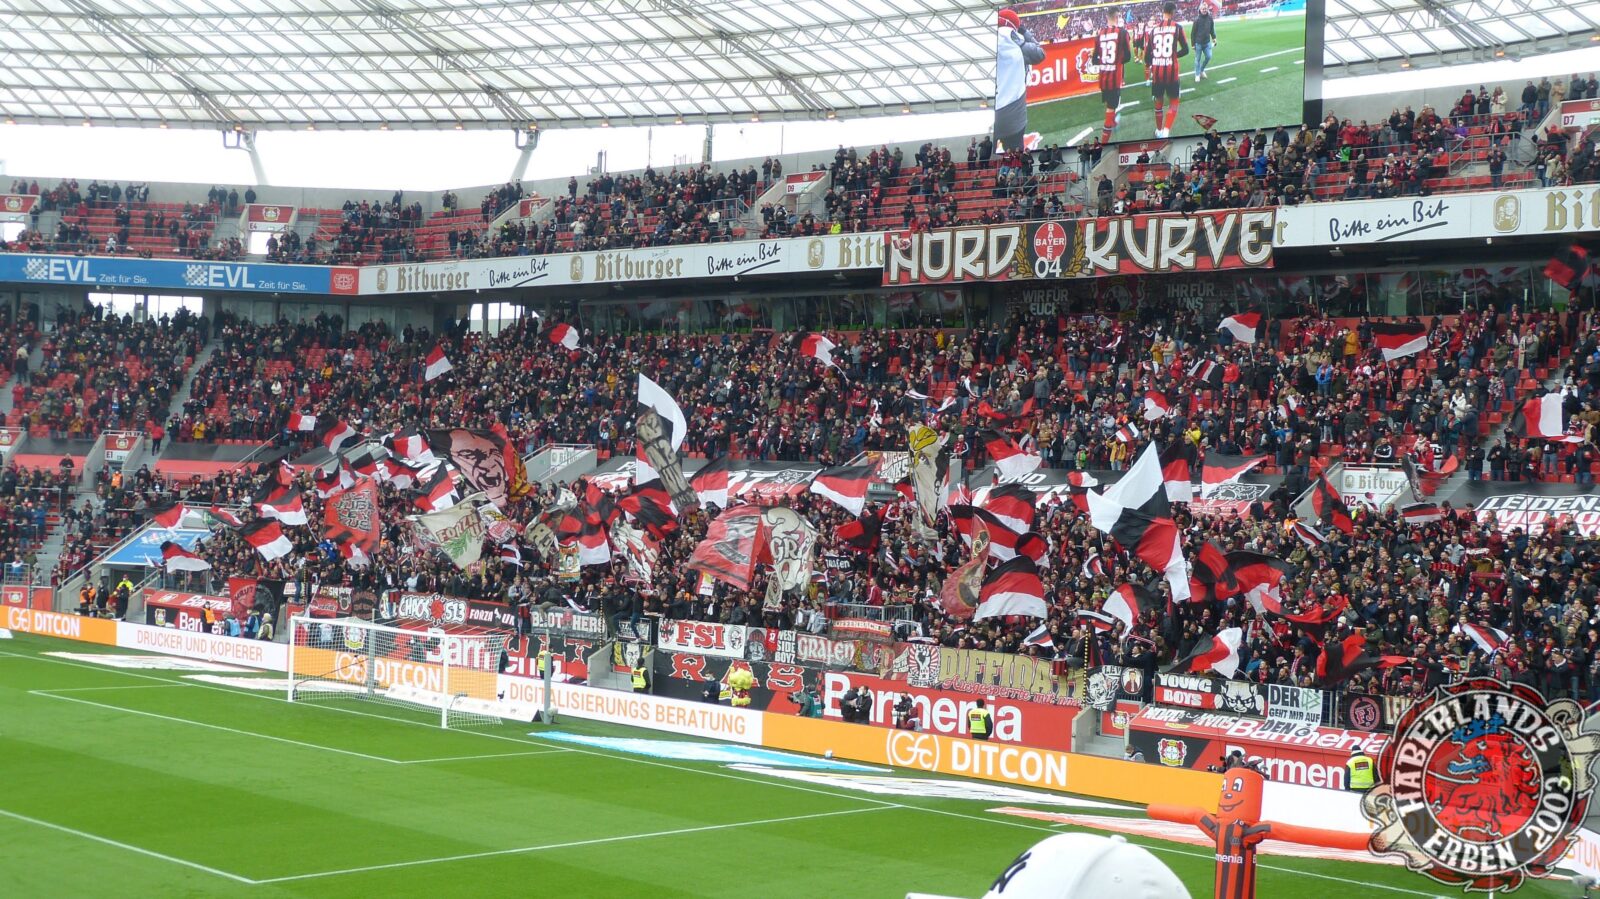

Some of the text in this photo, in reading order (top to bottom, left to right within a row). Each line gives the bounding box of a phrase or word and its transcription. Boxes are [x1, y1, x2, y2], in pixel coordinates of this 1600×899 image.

[1100, 41, 1116, 64] 13
[1152, 34, 1174, 58] 38
[1564, 115, 1574, 126] D7
[1329, 199, 1450, 243] Bitte ein Bit
[888, 209, 1274, 283] NORD KURVE
[1034, 237, 1066, 247] BAYER
[49, 258, 150, 284] EVL Zeit für Sie.
[594, 253, 684, 282] Bitburger
[707, 242, 782, 276] Bitte ein Bit
[1035, 256, 1063, 279] 04
[208, 265, 308, 291] EVL Zeit für Sie.
[396, 266, 470, 292] Bitburger
[489, 258, 549, 288] Bitte ein Bit
[1022, 287, 1068, 302] WIR FÜR
[1168, 282, 1214, 298] IHR FÜR
[1344, 496, 1356, 506] D2
[399, 595, 431, 619] CHAOS
[444, 600, 467, 623] S13
[469, 608, 494, 622] FORZA
[35, 612, 80, 638] DITCON
[676, 621, 726, 650] FSI
[137, 629, 263, 663] DRUCKER UND KOPIERER
[774, 652, 796, 664] BOYZ
[777, 640, 796, 653] SIDE
[374, 660, 440, 692] DITCON
[1158, 674, 1212, 693] YOUNG
[510, 682, 746, 735] DIGITALISIERUNGS BERATUNG
[1163, 689, 1202, 706] BOYS
[1269, 686, 1300, 707] DER
[1262, 718, 1294, 735] DEN
[1268, 709, 1321, 723] GEHT MIR AUF
[951, 740, 1067, 786] DITCON
